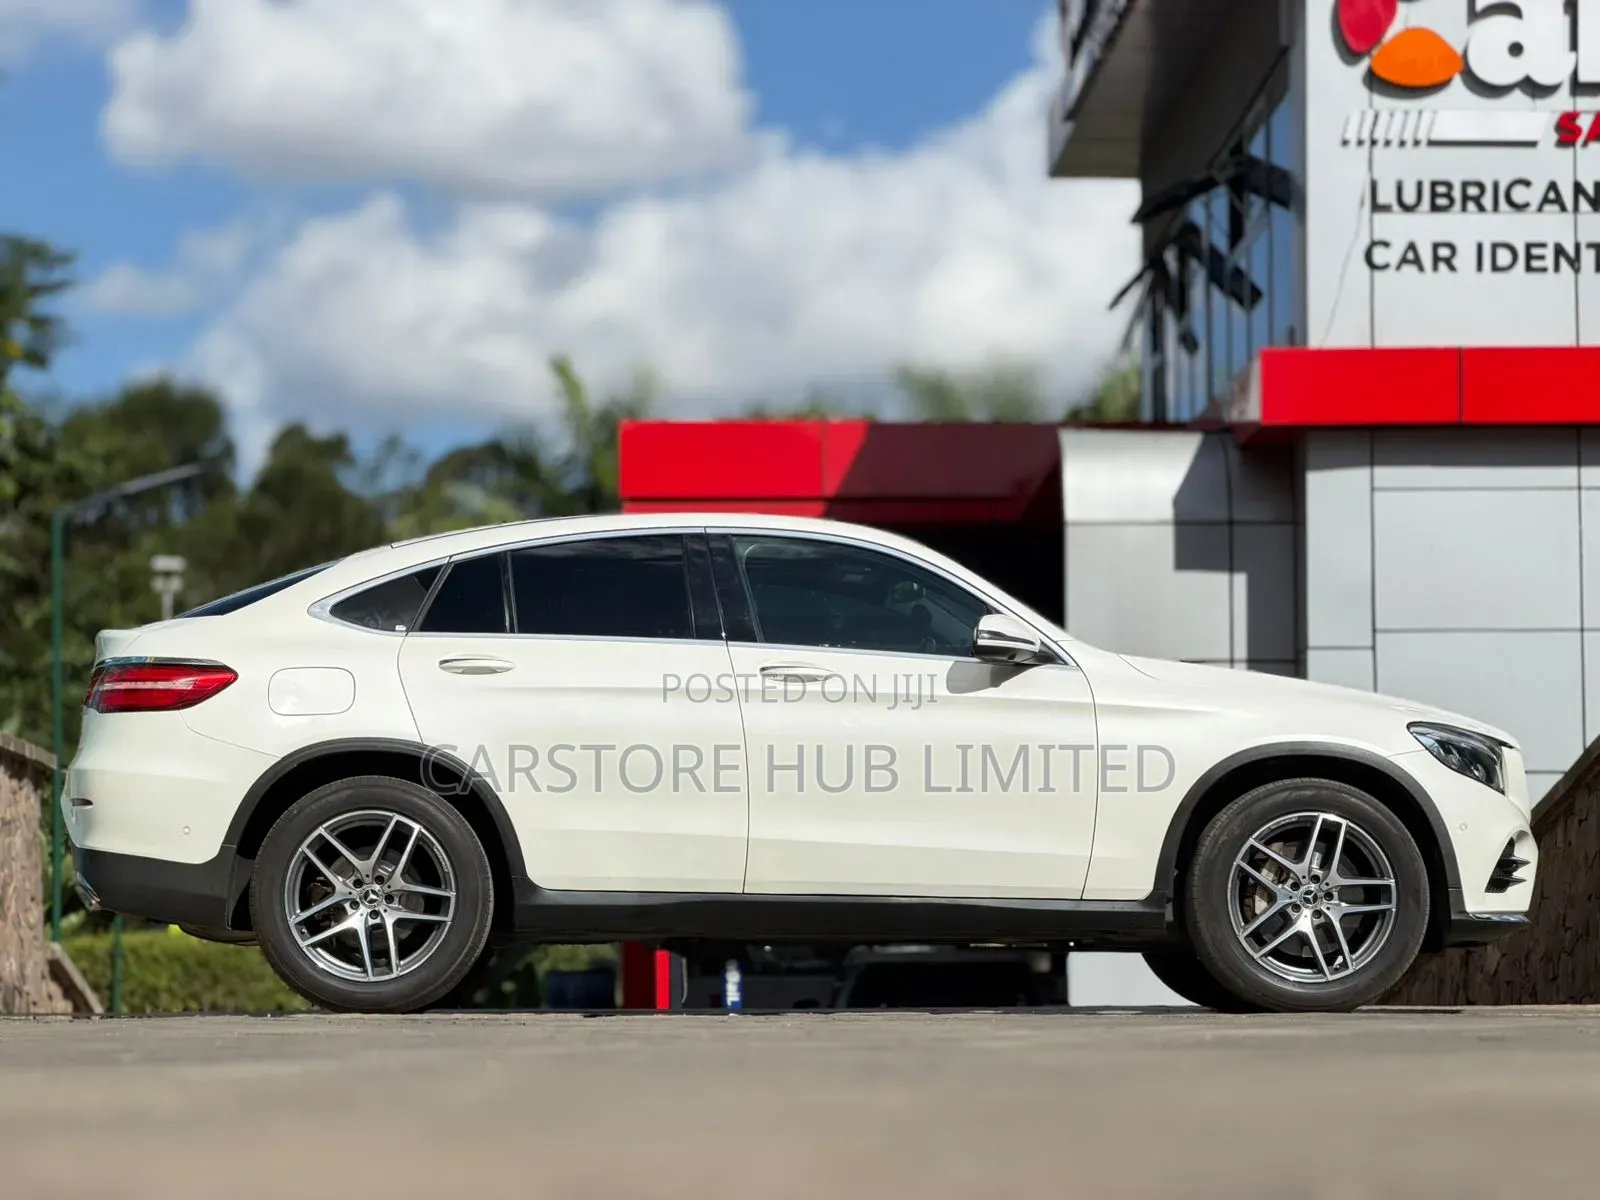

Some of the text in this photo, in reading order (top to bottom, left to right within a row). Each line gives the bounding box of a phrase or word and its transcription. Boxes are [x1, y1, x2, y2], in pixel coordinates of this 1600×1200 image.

[1371, 178, 1600, 213] LUBRICAN
[1364, 240, 1600, 273] CAR IDENT
